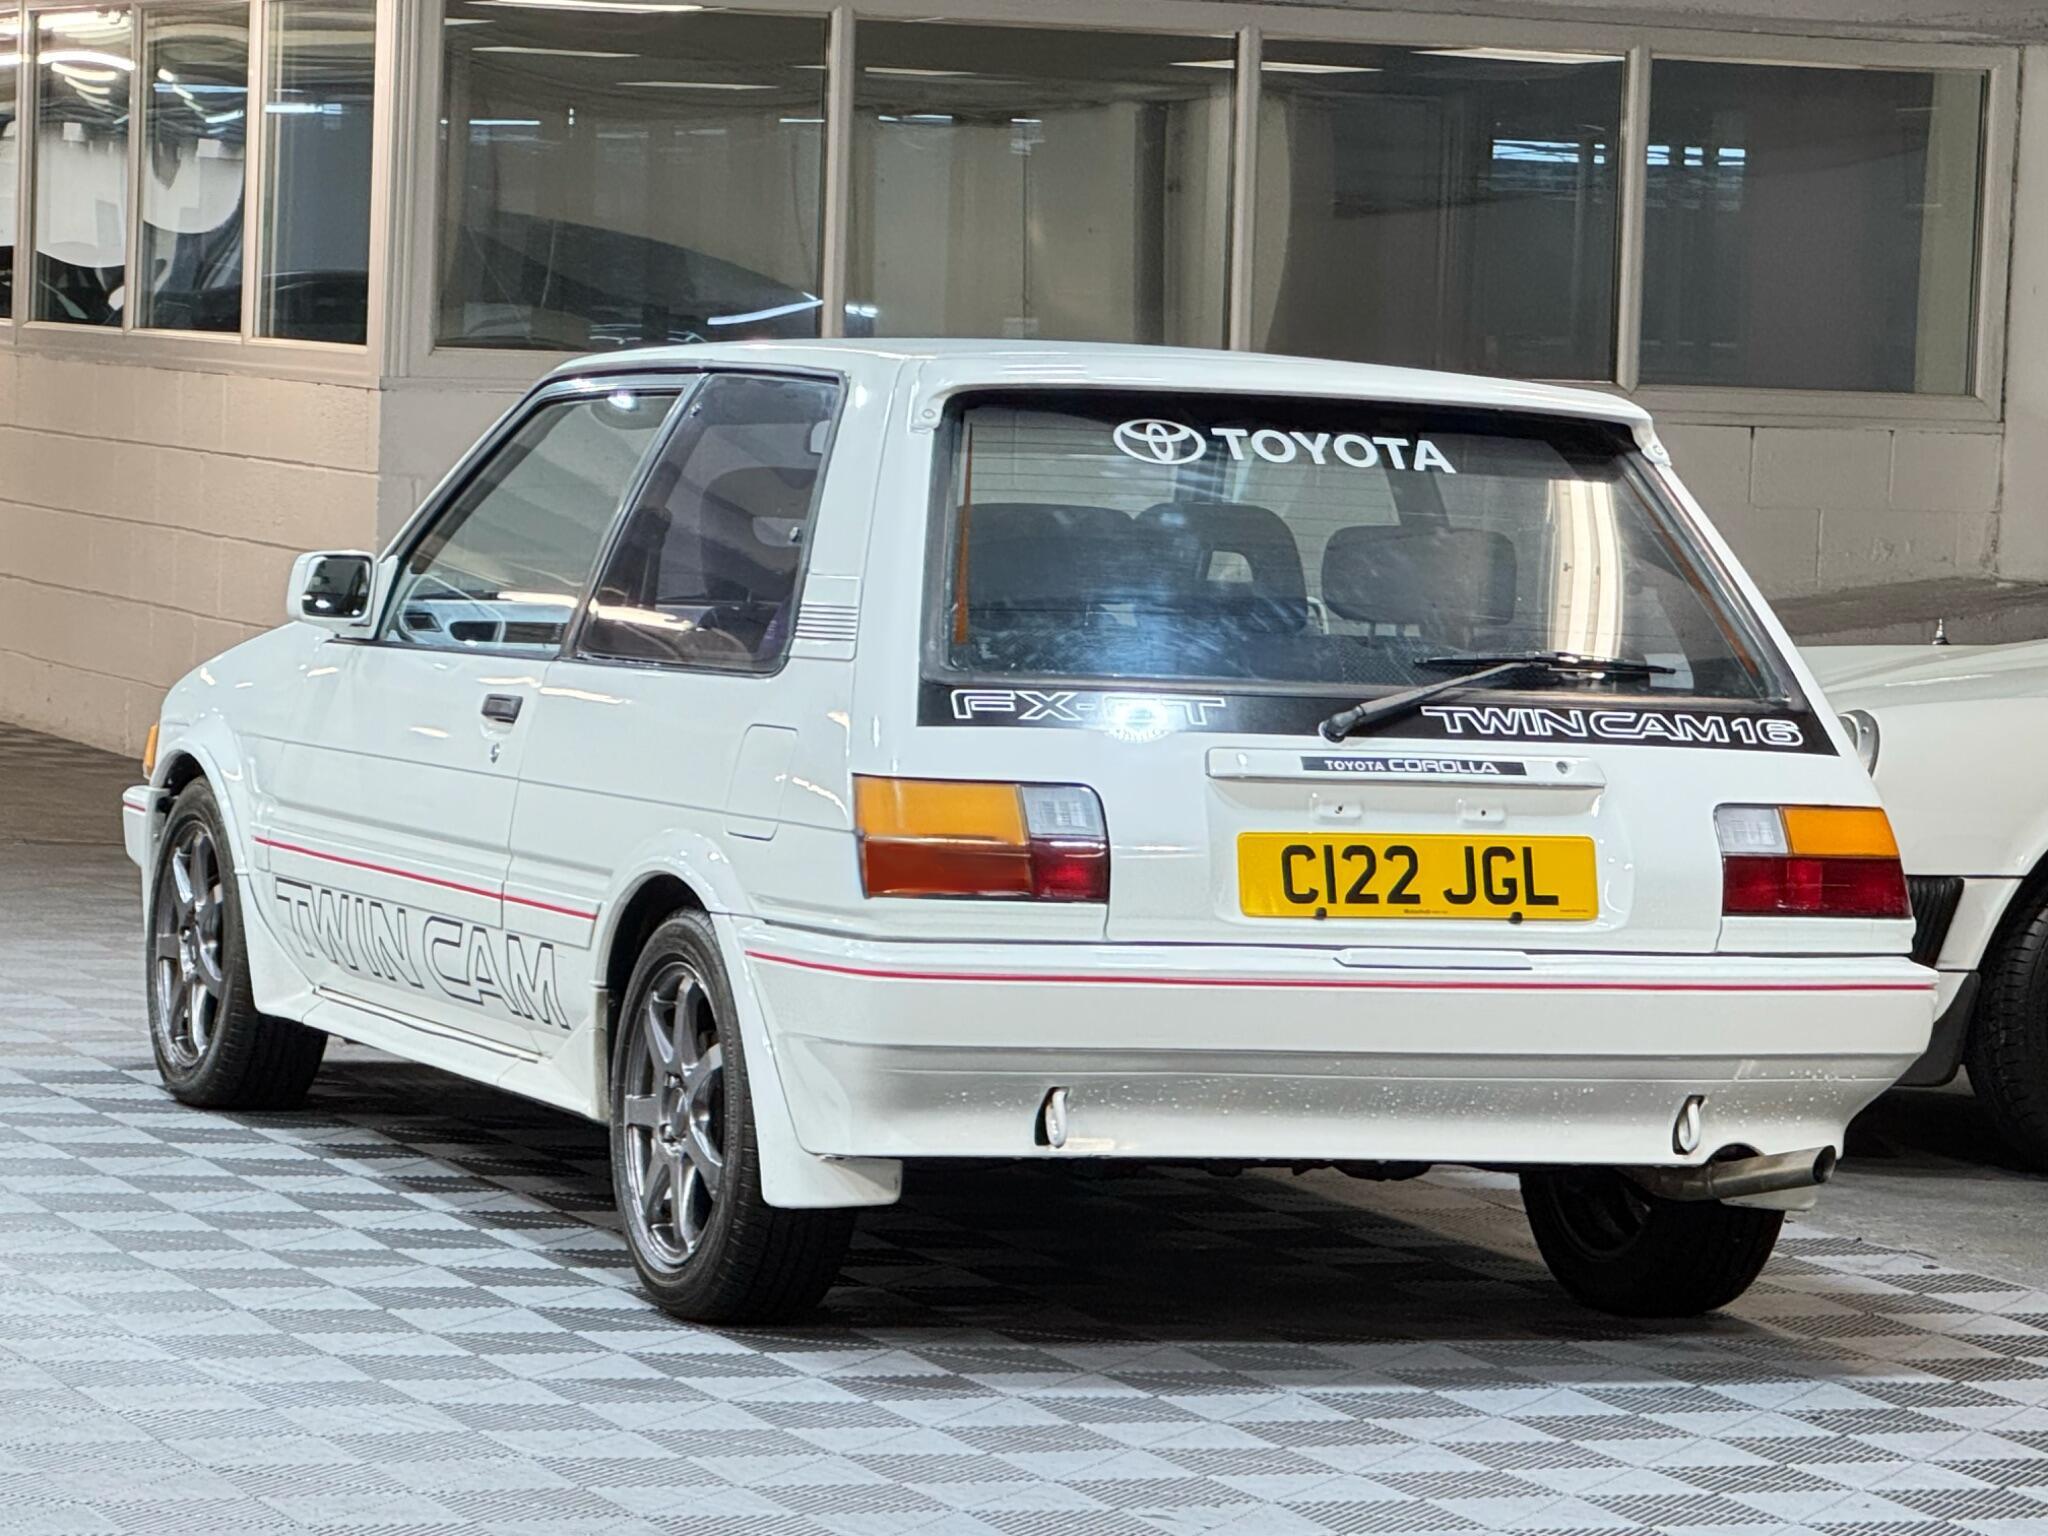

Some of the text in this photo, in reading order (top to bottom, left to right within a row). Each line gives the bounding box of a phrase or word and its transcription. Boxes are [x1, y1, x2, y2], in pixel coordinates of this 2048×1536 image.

[1211, 427, 1457, 474] TOYOTA
[1324, 759, 1500, 774] TOYOTA COROLLA
[1280, 844, 1559, 907] C122 JGL
[275, 876, 571, 1031] TWIN CAM
